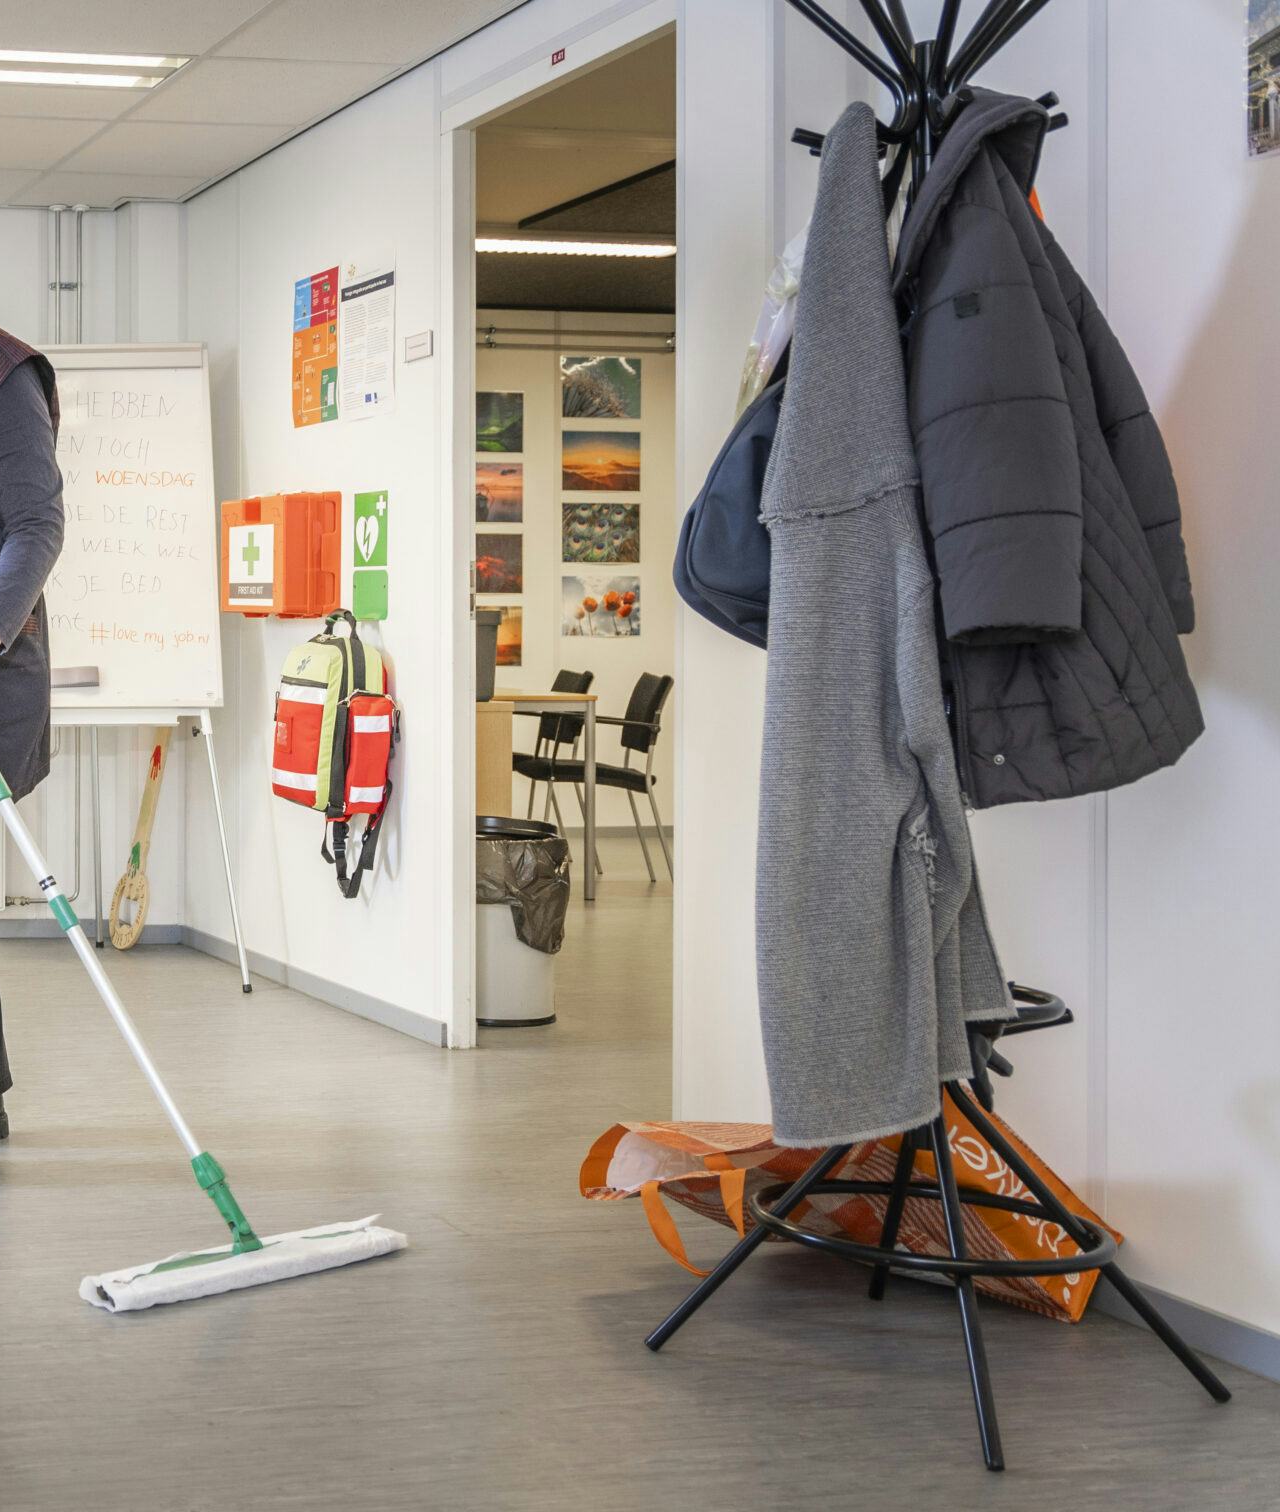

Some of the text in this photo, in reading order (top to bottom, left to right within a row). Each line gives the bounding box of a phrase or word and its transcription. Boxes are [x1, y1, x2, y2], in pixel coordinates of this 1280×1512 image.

[76, 390, 176, 419] HEBBEN
[96, 470, 195, 487] WOENSDAG
[147, 505, 188, 534] REST
[82, 537, 144, 556] WEEK
[122, 572, 161, 594] BED
[88, 622, 140, 645] #love
[143, 631, 165, 652] my
